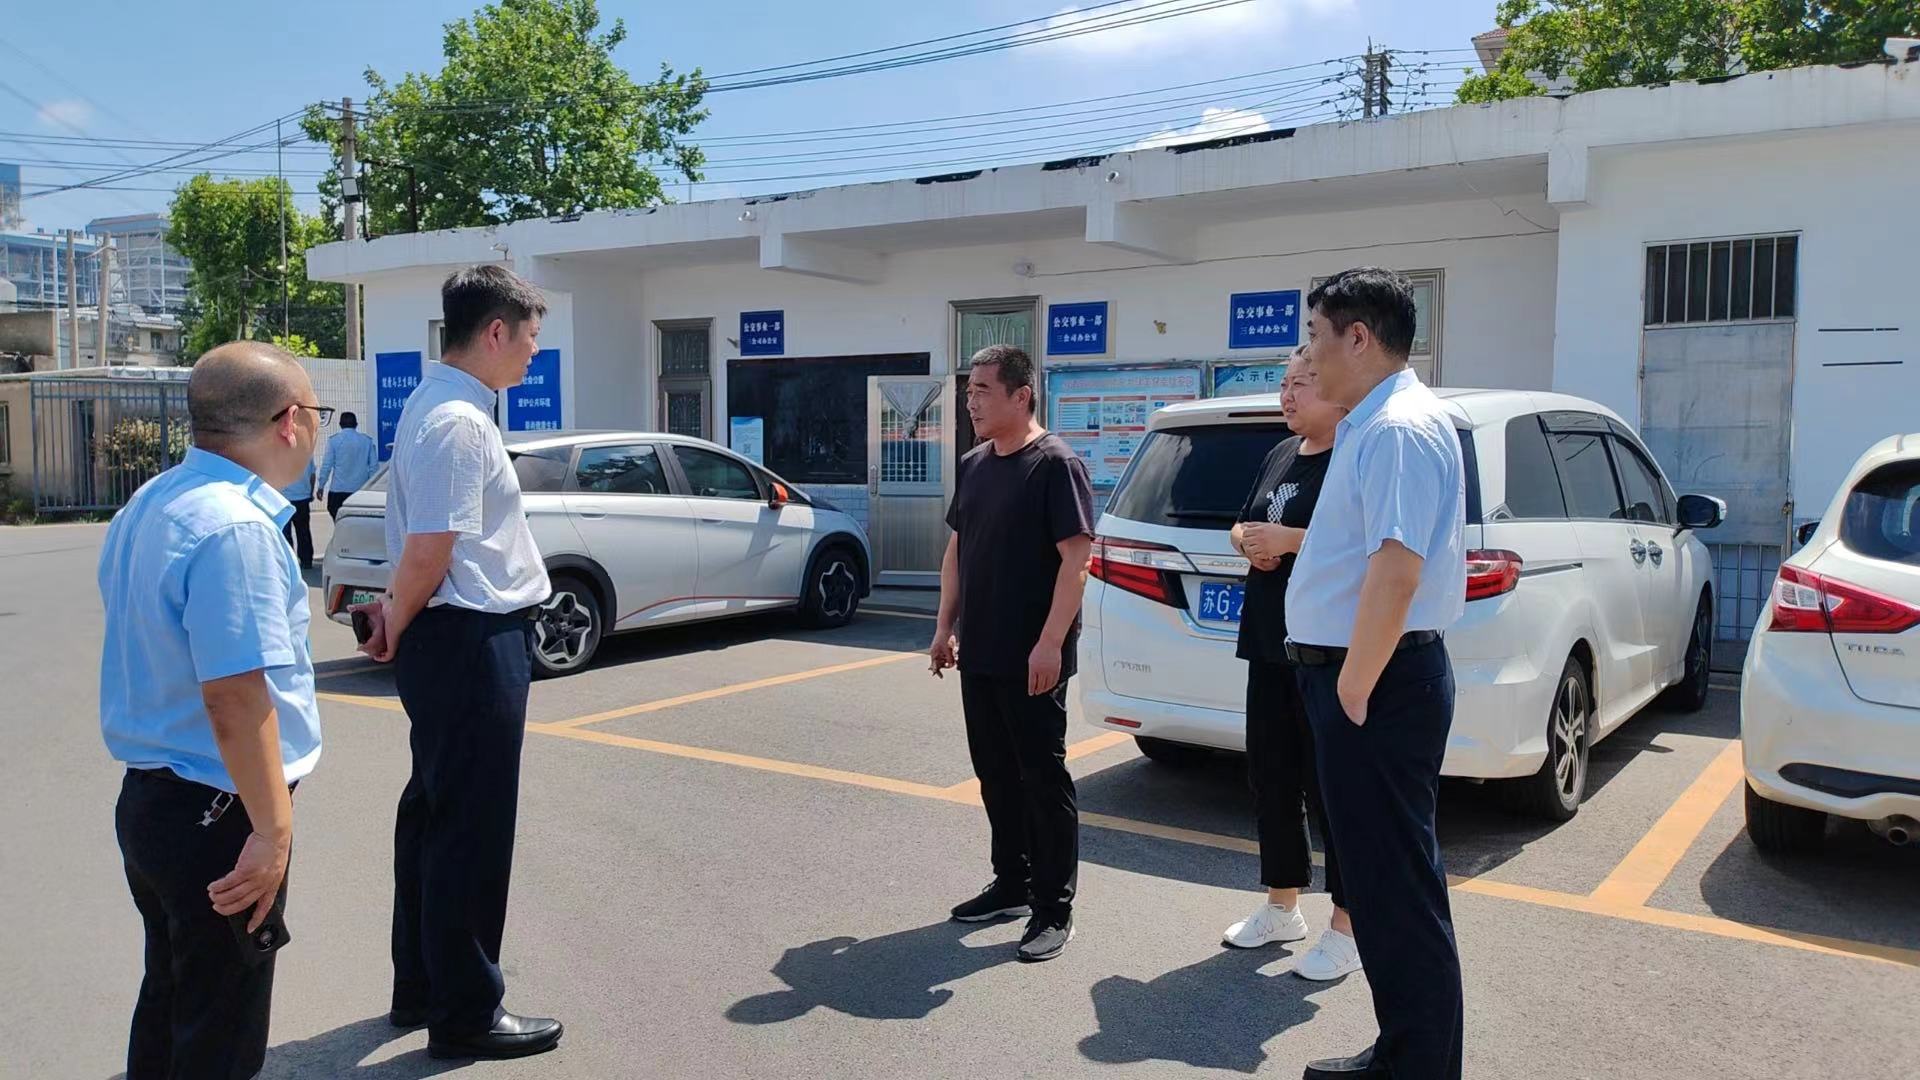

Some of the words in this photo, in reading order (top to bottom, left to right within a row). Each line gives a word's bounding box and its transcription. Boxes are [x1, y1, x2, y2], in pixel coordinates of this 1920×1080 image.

[1236, 304, 1294, 319] 公交事业一部
[1053, 314, 1102, 328] 公交事业一部
[1240, 323, 1288, 335] 三公司办公室
[1235, 370, 1275, 382] 公示栏
